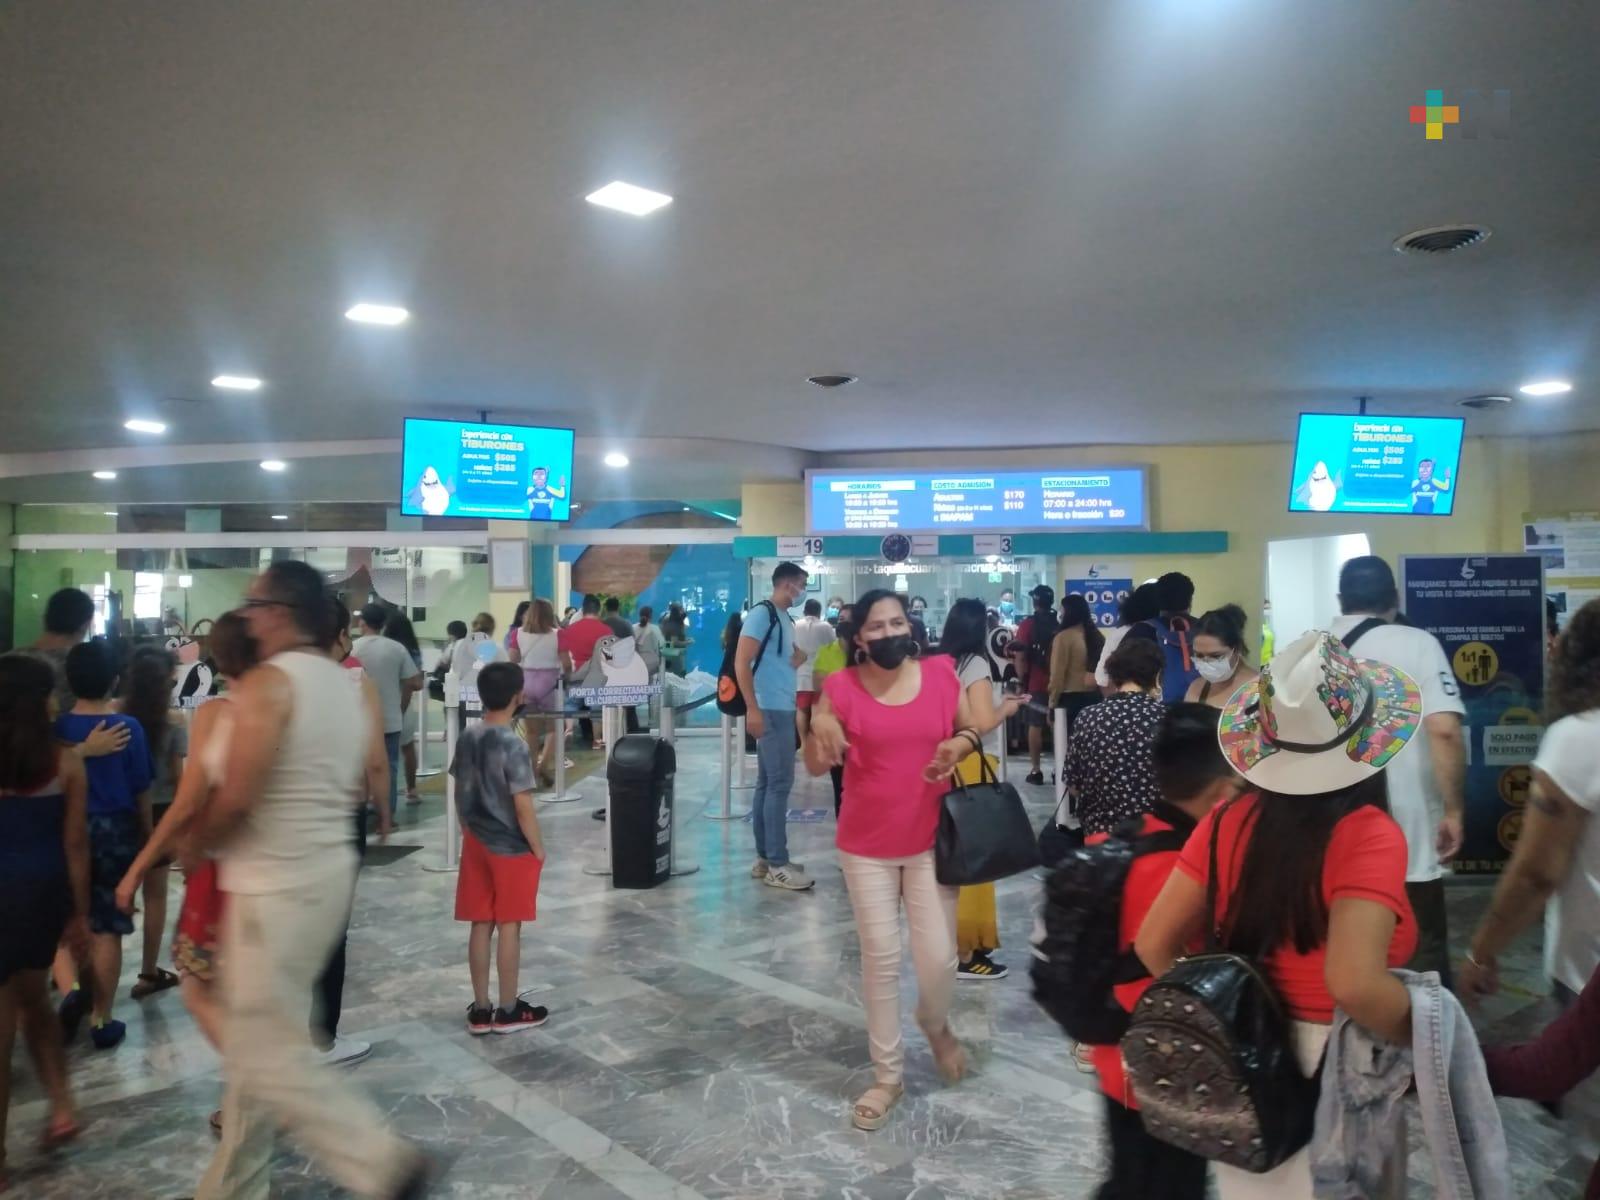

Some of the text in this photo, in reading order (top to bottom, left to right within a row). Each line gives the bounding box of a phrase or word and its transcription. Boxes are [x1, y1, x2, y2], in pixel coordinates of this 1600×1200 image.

[1353, 433, 1413, 442] TIBURONES
[462, 439, 524, 450] TIBURONES
[1044, 479, 1108, 487] ESTACIONAMIENTO
[1004, 490, 1024, 499] $170
[1004, 501, 1024, 510] $110
[1044, 499, 1066, 507] 07:00
[1075, 499, 1098, 507] 24:00
[804, 539, 823, 553] 19
[1002, 538, 1011, 552] 3
[598, 686, 663, 696] CORRECTAMENTE
[1490, 733, 1538, 743] SOLO PAGO
[1488, 745, 1500, 755] EN
